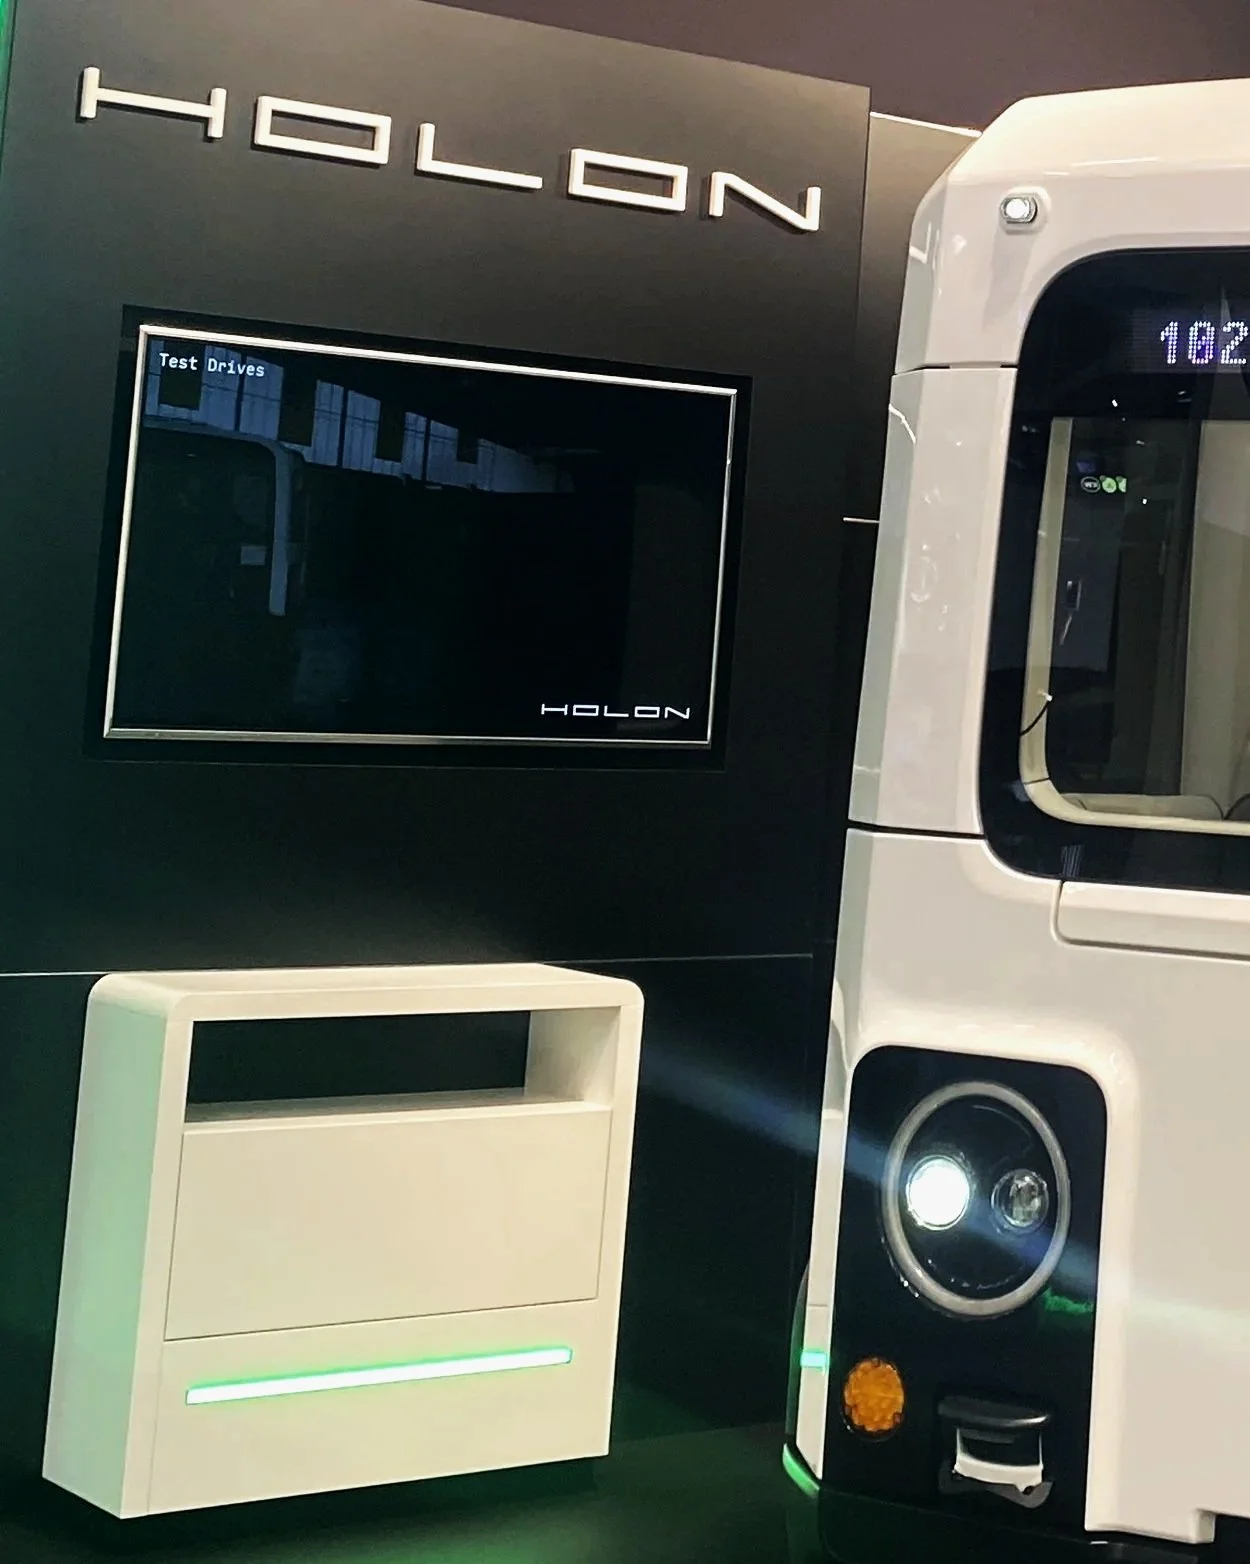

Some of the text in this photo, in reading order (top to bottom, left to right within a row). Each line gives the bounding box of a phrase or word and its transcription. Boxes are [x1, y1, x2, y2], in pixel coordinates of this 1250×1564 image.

[80, 66, 821, 232] HOLON
[1160, 321, 1248, 364] 102
[159, 352, 265, 377] Test Drives
[541, 703, 691, 720] HOLON
